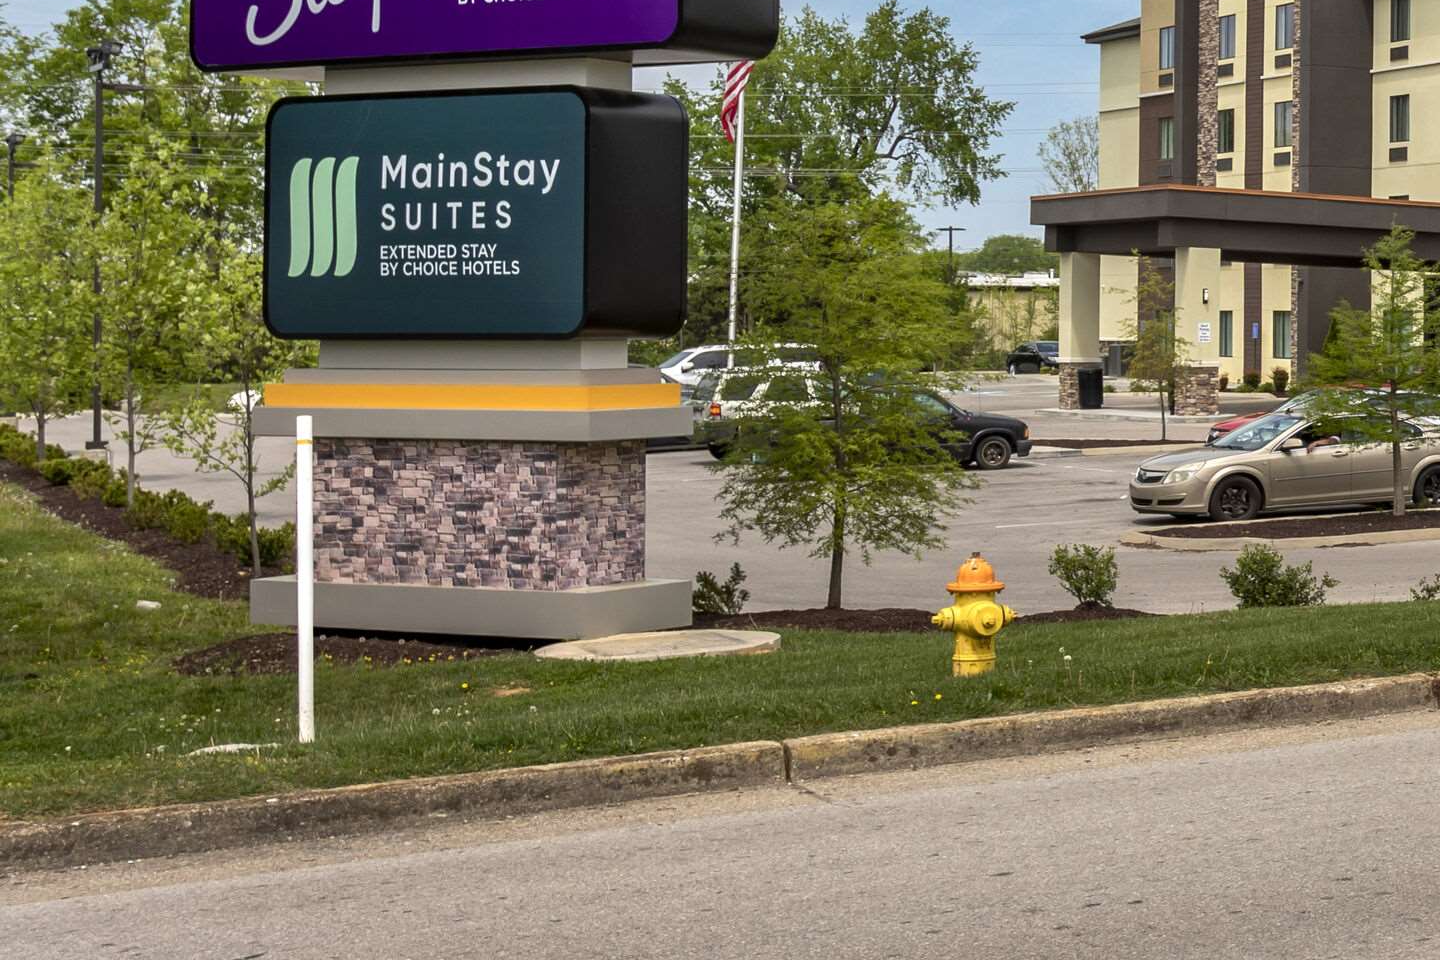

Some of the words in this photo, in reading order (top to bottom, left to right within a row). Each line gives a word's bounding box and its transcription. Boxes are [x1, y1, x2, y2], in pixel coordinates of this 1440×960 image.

[381, 151, 561, 195] MainStay
[380, 200, 512, 231] SUITES
[380, 244, 457, 260] EXTENDED
[461, 243, 497, 259] STAY
[380, 261, 399, 276] BY
[402, 260, 458, 276] CHOICE
[462, 259, 520, 276] HOTELS
